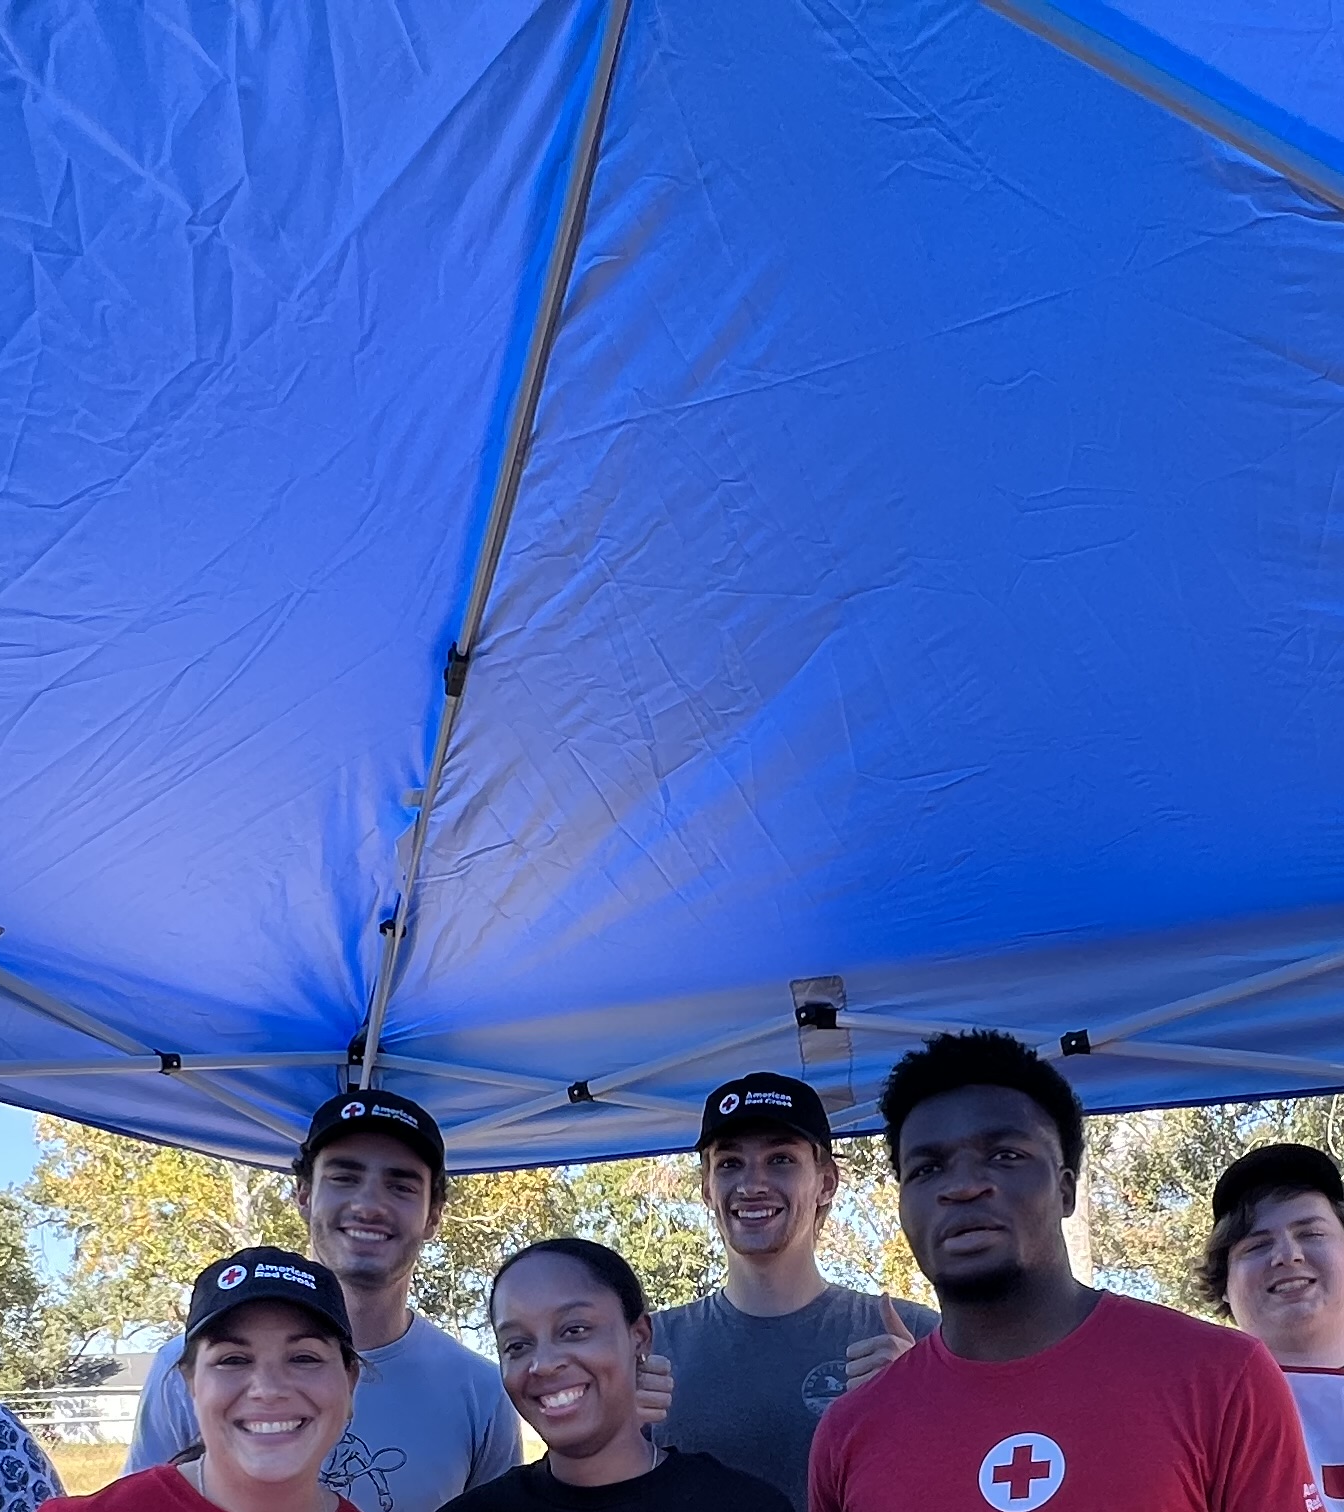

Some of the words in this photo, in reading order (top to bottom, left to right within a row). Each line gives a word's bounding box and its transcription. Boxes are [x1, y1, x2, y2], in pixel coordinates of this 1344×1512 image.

[746, 1091, 792, 1102] American
[372, 1104, 419, 1126] American
[254, 1270, 280, 1279] Red
[282, 1272, 317, 1290] Cross
[255, 1263, 317, 1282] American
